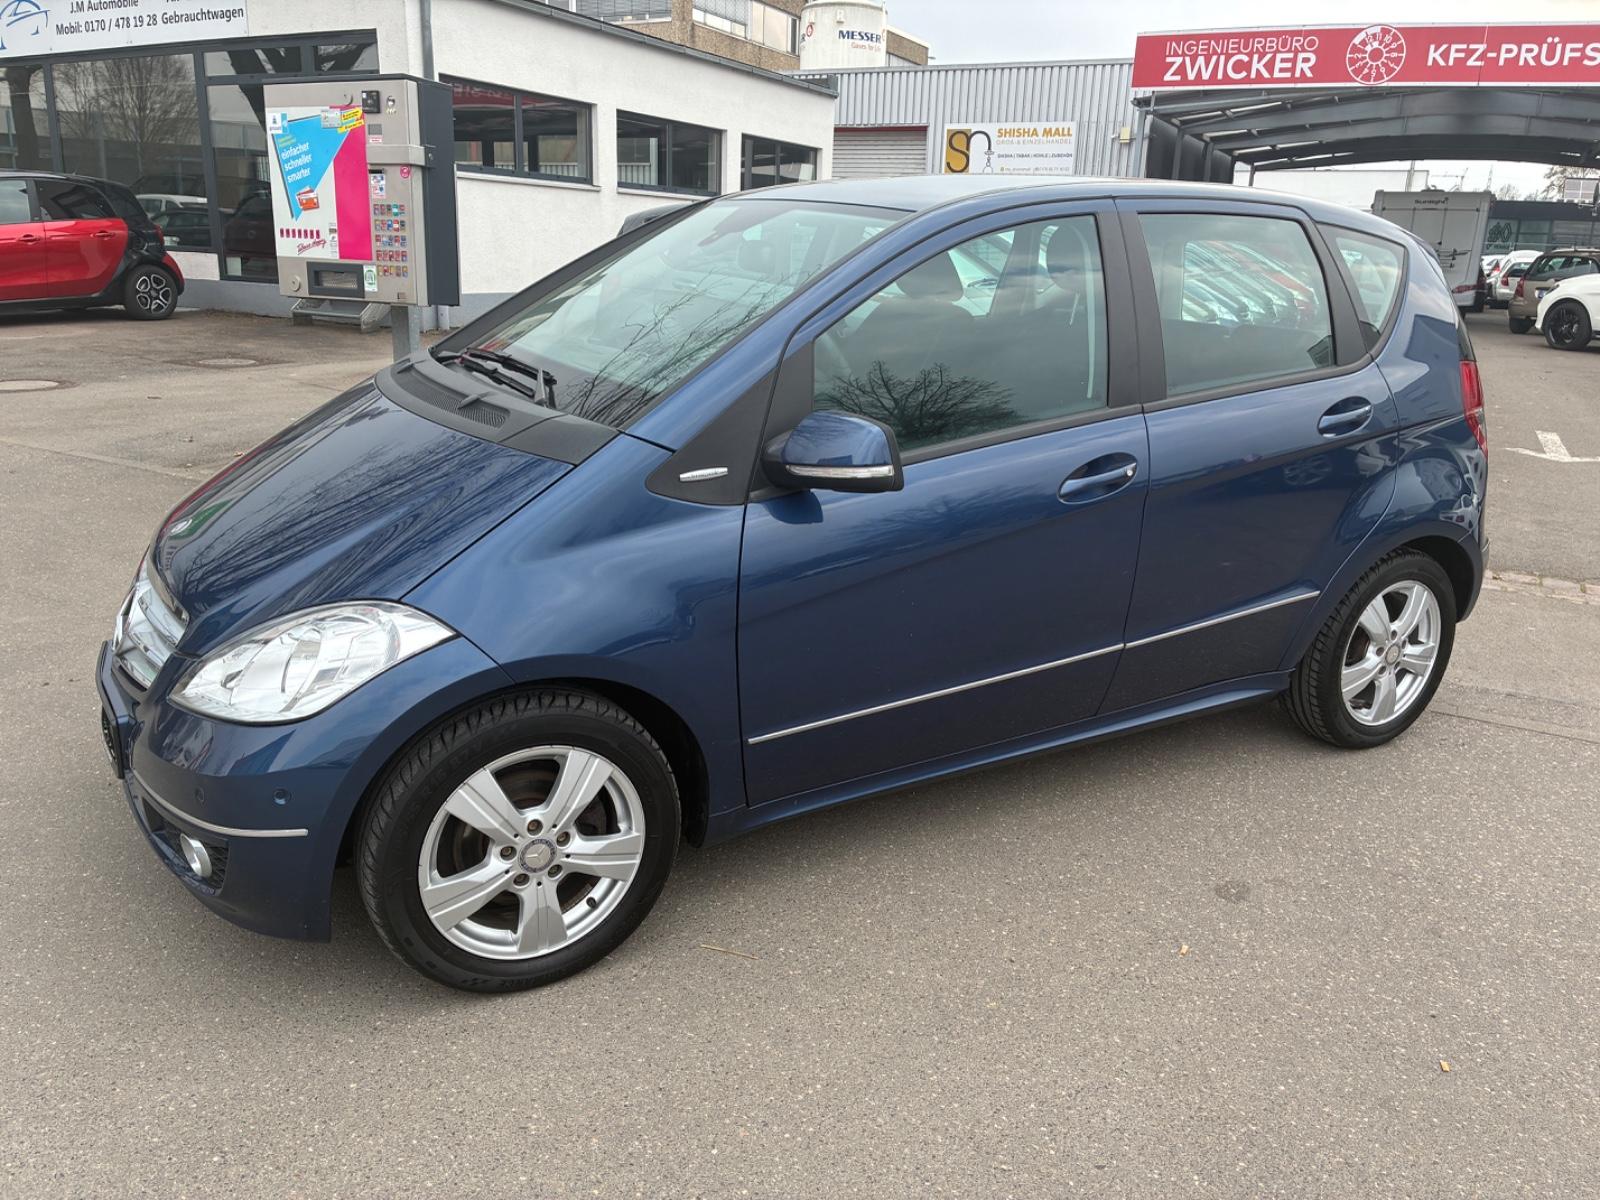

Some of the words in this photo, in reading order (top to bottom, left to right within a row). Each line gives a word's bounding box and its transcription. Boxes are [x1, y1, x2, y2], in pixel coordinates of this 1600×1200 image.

[70, 0, 85, 14] J.M
[87, 0, 139, 12] Automobile
[55, 21, 83, 36] Mobil:
[84, 18, 106, 33] 0170
[108, 18, 113, 32] /
[114, 16, 131, 29] 478
[133, 15, 145, 28] 19
[146, 13, 158, 27] 28
[161, 7, 244, 25] Gebrauchtwagen
[838, 29, 882, 44] MESSER
[1166, 35, 1319, 56] INGENIEURBÜRO
[1426, 36, 1600, 67] KFZ-PRÜFS
[1163, 52, 1317, 82] ZWICKER
[997, 127, 1039, 138] SHISHA
[1041, 126, 1073, 138] MALL
[281, 142, 310, 160] einfacher
[284, 154, 312, 172] schneller
[287, 167, 311, 183] smarter
